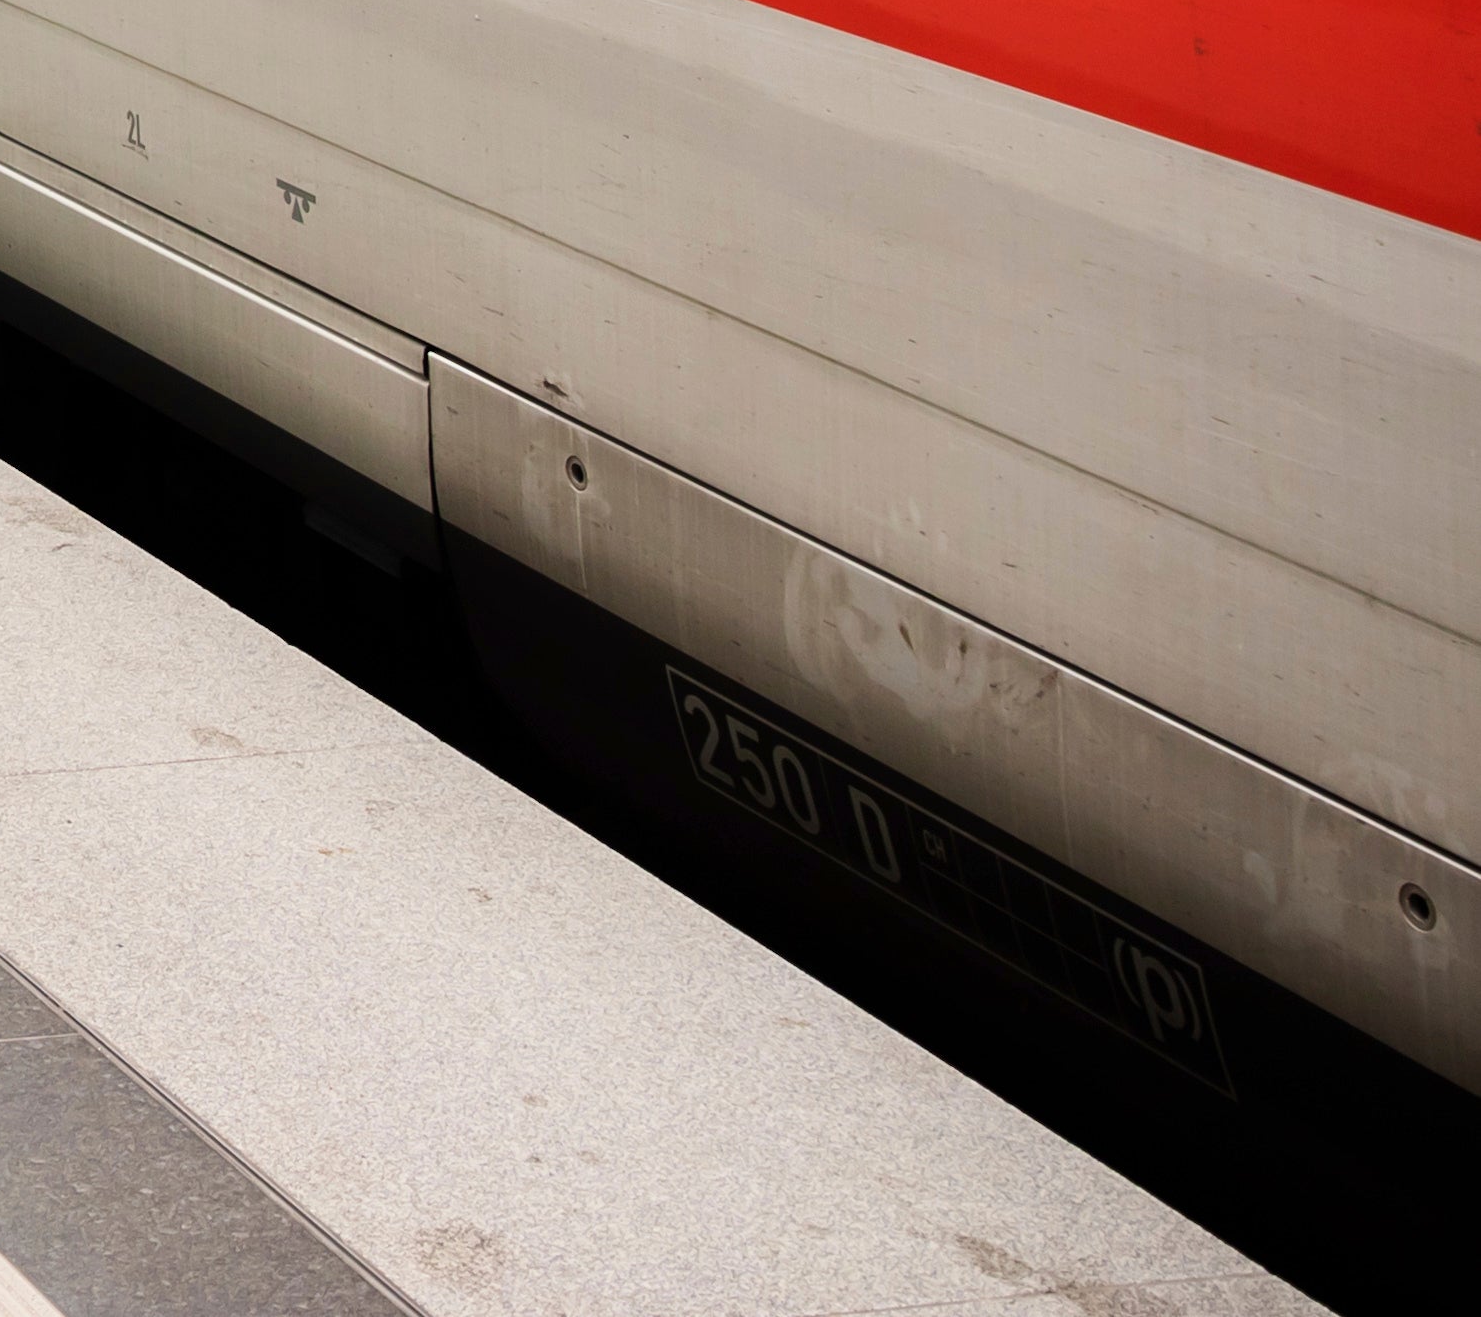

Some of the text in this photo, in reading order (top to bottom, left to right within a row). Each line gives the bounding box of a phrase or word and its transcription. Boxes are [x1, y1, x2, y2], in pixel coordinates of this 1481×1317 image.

[126, 110, 146, 150] 2L
[683, 693, 821, 836] 250
[922, 827, 946, 864] CH
